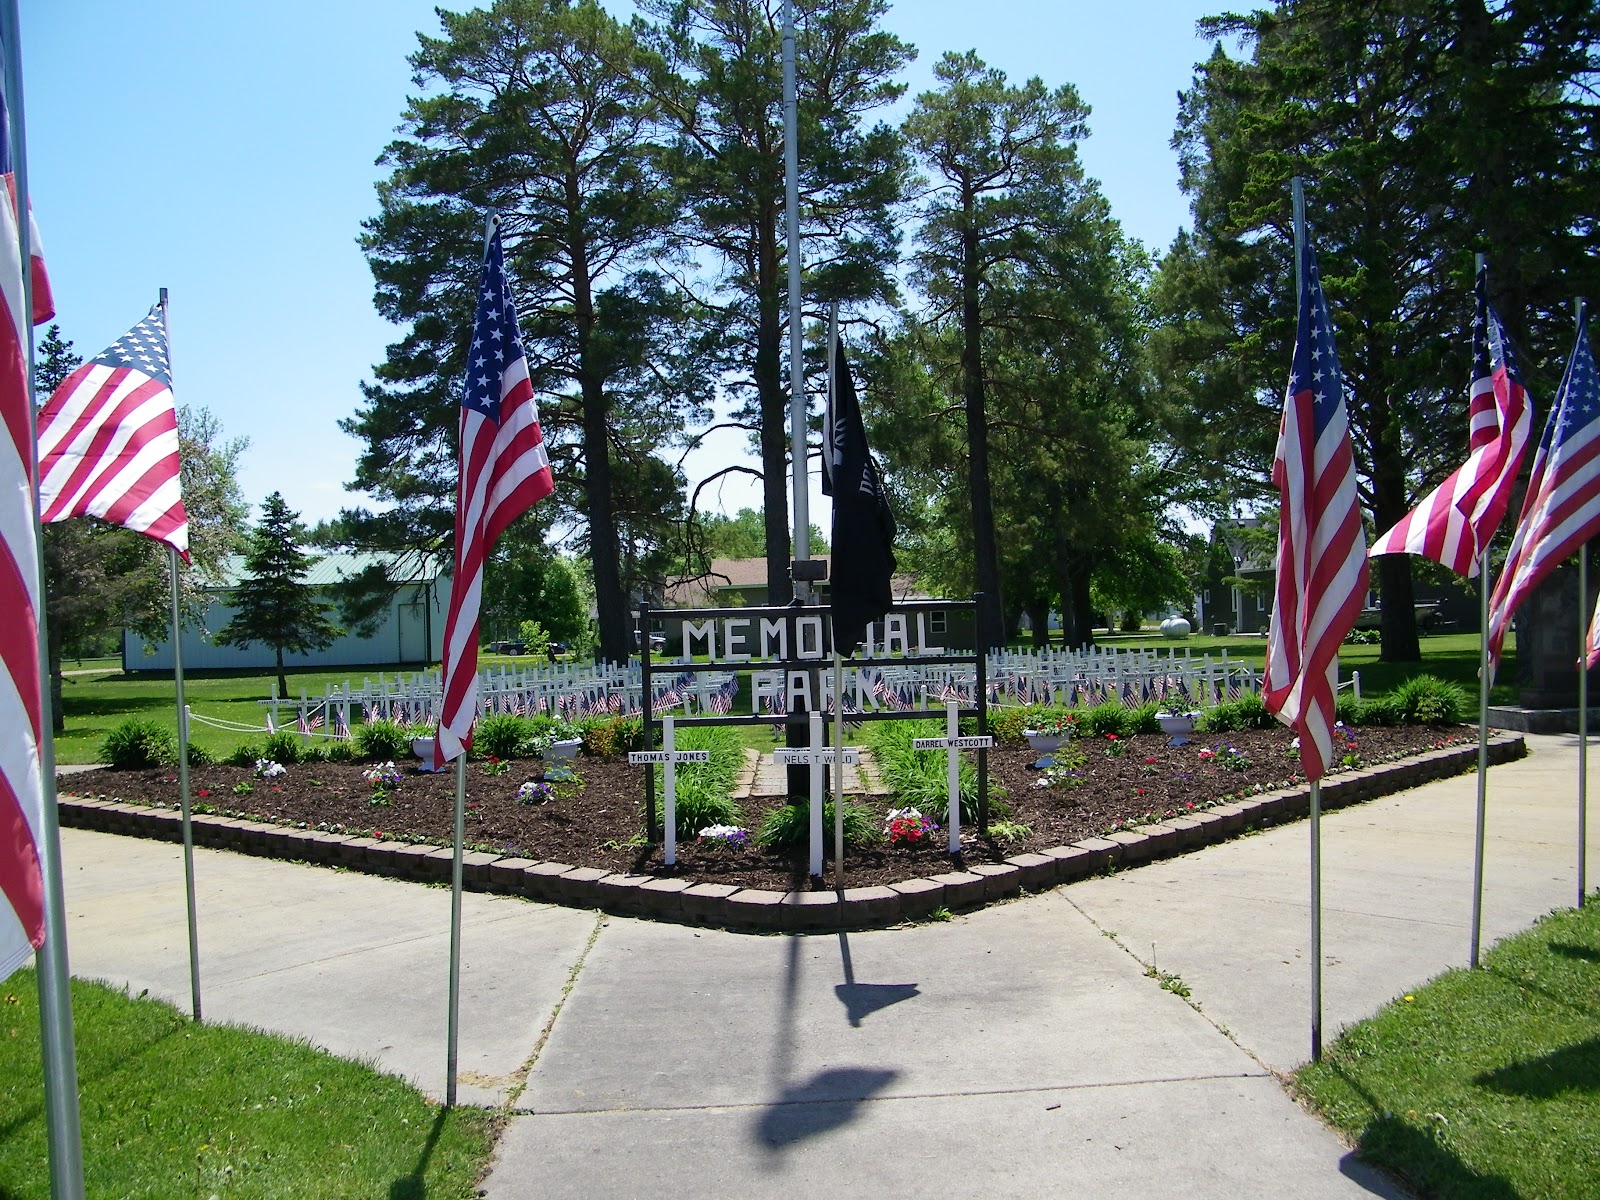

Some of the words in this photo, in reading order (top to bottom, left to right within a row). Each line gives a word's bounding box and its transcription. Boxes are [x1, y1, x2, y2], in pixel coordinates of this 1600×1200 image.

[682, 613, 944, 661] MEMOIAL
[915, 740, 944, 749] DARREL
[947, 738, 990, 748] WESTCOTT
[631, 753, 670, 762] THOMAS
[676, 752, 707, 761] JONES
[784, 755, 809, 764] NELS
[824, 755, 852, 764] WD
